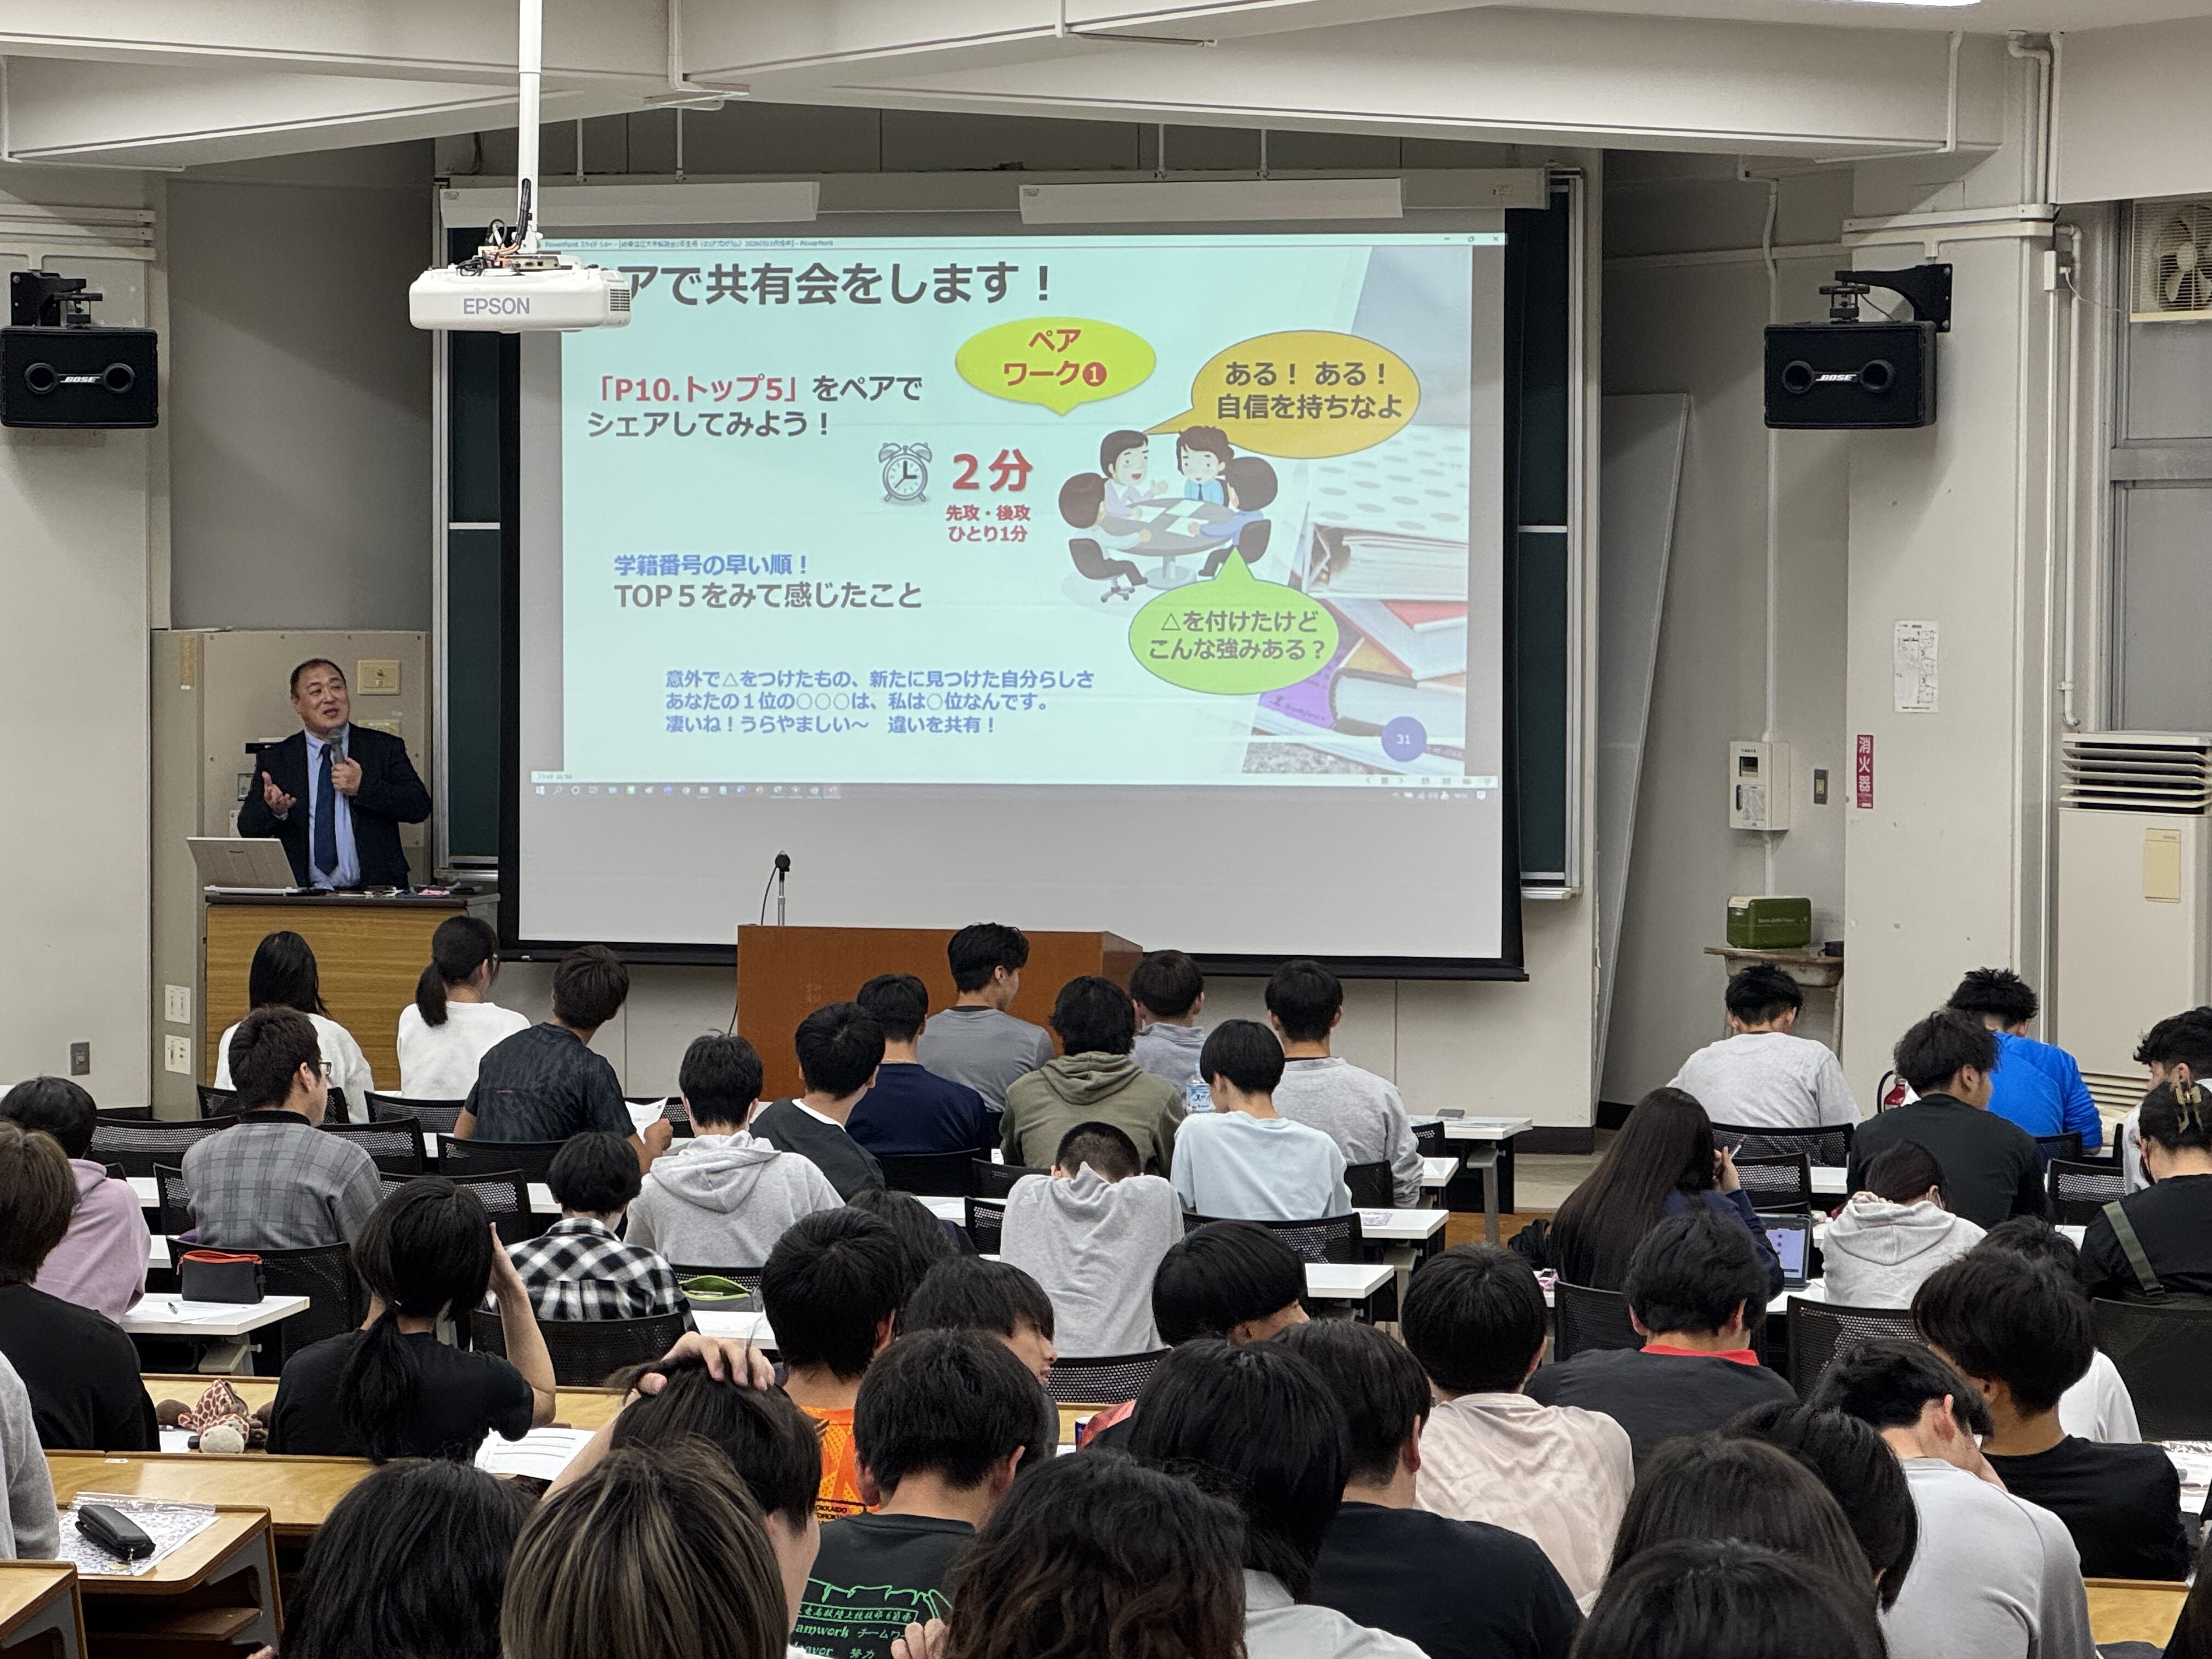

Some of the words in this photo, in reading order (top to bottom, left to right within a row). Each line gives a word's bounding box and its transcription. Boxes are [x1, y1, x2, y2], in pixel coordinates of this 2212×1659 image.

[618, 262, 1049, 306] アで共有会をします！
[463, 297, 530, 315] EPSON
[1029, 329, 1081, 352] ペア
[1218, 393, 1402, 420] 自信を持ちなよ
[588, 410, 828, 437] シェアしてみよう！
[946, 504, 1030, 521] 先攻・後攻
[948, 525, 1028, 542] ひとり1分
[614, 554, 806, 575] 学籍番号の早い順！
[1150, 637, 1325, 660] こんな強みある？
[1397, 734, 1411, 744] 31
[1858, 736, 1871, 792] 消火器
[815, 1504, 848, 1514] OKKAIDO
[795, 1623, 850, 1639] amwork
[857, 1627, 905, 1640] チームワ
